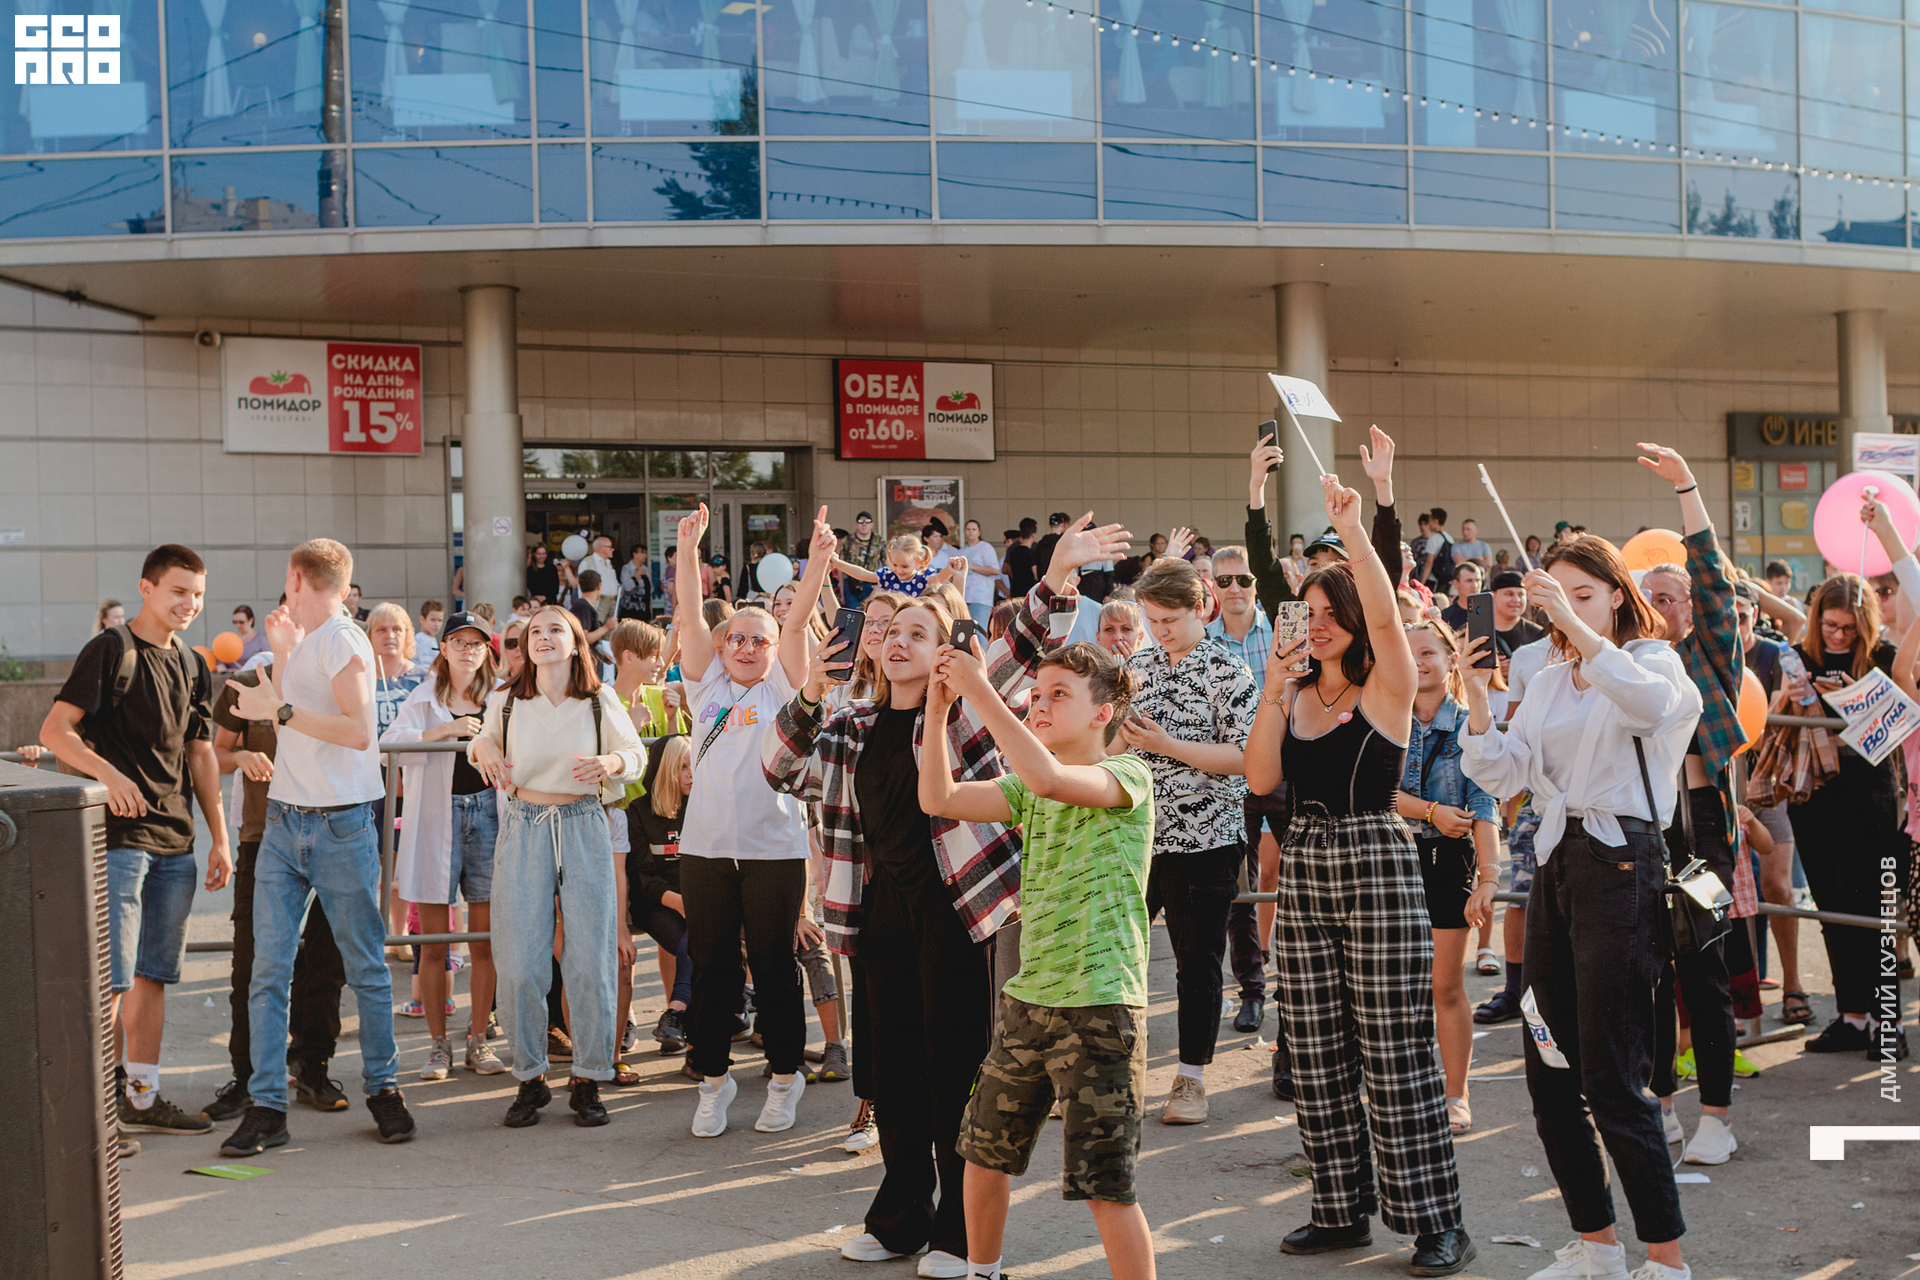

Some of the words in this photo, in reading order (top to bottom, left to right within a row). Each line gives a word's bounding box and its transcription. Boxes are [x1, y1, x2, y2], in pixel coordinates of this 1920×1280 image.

[331, 354, 415, 372] СКИДКА
[344, 374, 366, 385] НА
[366, 375, 404, 387] ДЕНЬ
[333, 386, 415, 400] РОЖДЕНИЯ
[238, 397, 321, 412] ПОМИДОР
[846, 403, 853, 414] В
[856, 404, 919, 416] ПОМИДОРЕ
[343, 400, 413, 444] 15%
[928, 412, 988, 424] ПОМИДОР
[893, 485, 922, 502] БИГ
[1857, 718, 1880, 748] INTER
